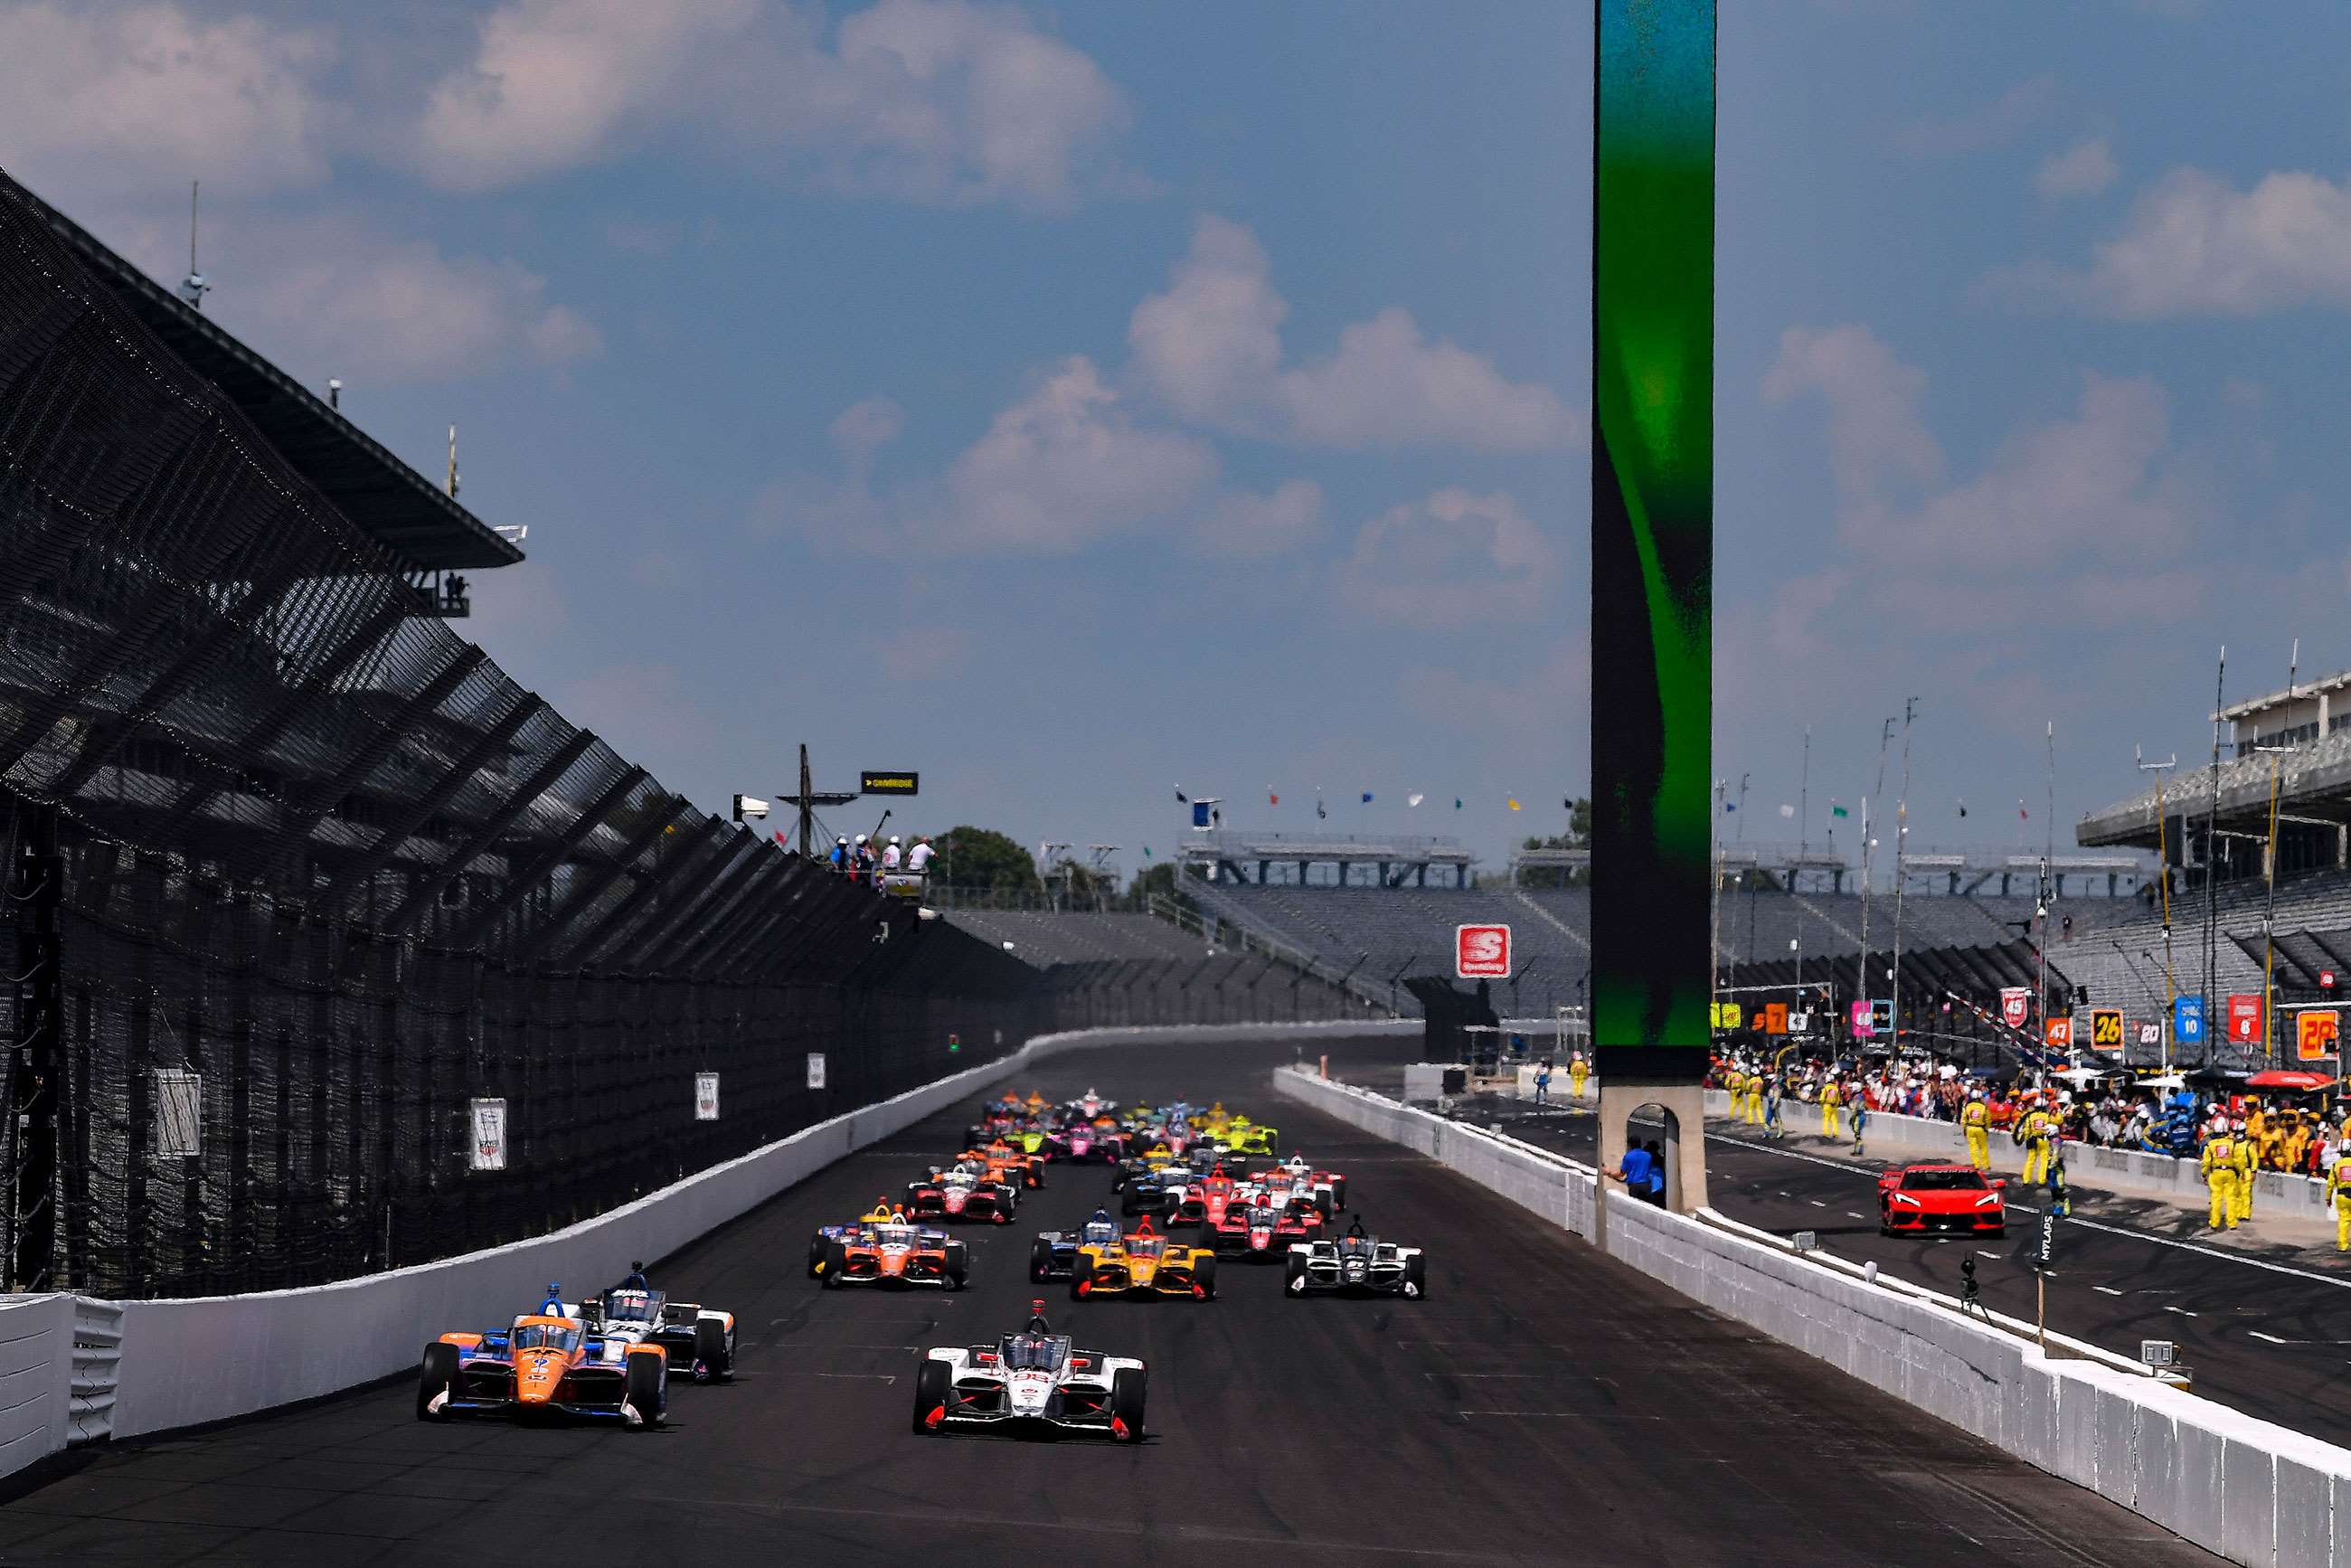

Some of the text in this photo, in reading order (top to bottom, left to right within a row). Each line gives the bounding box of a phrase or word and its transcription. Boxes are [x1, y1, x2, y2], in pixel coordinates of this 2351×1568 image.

[2049, 1023, 2068, 1040] 47
[2096, 1015, 2120, 1043] 26
[2140, 1025, 2159, 1044] 20
[2185, 1019, 2198, 1034] 10
[2040, 1214, 2054, 1261] MYLAPS
